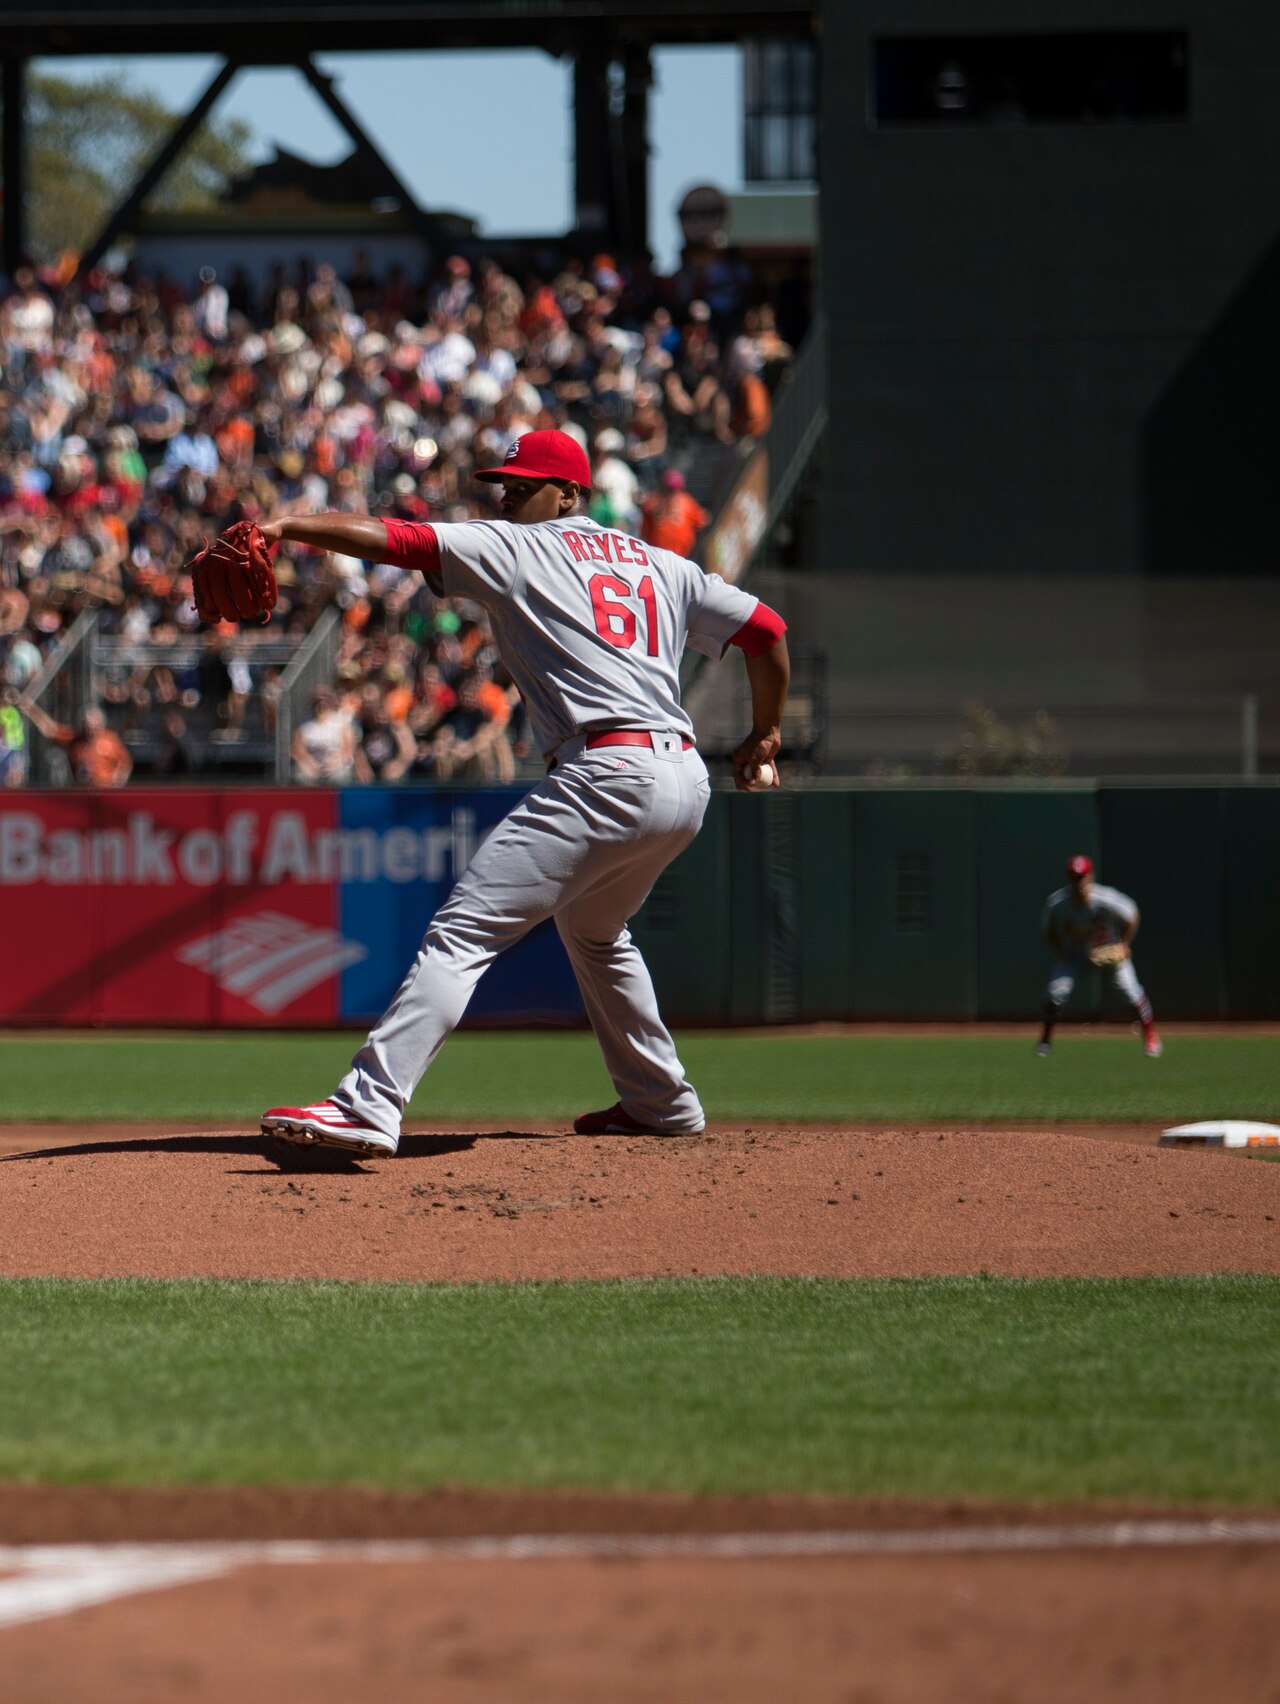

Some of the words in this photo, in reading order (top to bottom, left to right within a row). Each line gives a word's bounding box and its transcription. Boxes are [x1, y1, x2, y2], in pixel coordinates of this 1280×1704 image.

[562, 530, 649, 566] REYES
[588, 573, 659, 657] 61
[177, 810, 258, 886] of
[259, 809, 490, 886] Ameri
